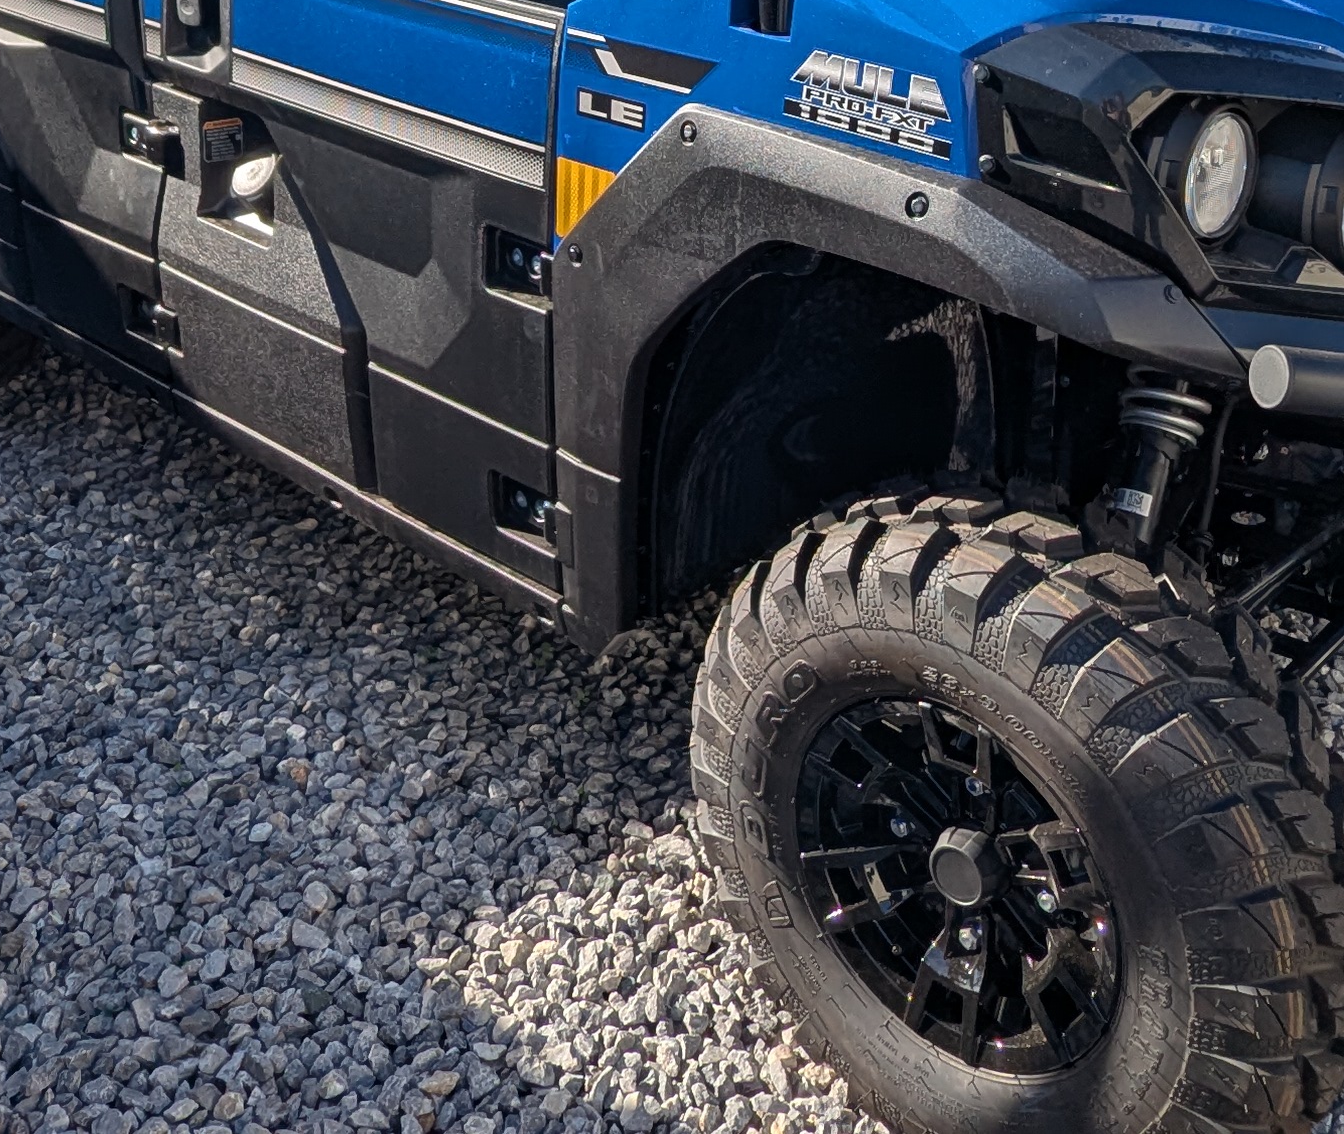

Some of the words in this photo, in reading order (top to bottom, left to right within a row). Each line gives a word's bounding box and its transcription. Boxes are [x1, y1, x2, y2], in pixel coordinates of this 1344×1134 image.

[579, 91, 644, 129] LE
[790, 49, 952, 123] MULE
[801, 85, 936, 133] PRO-FXT
[798, 104, 935, 153] 1000
